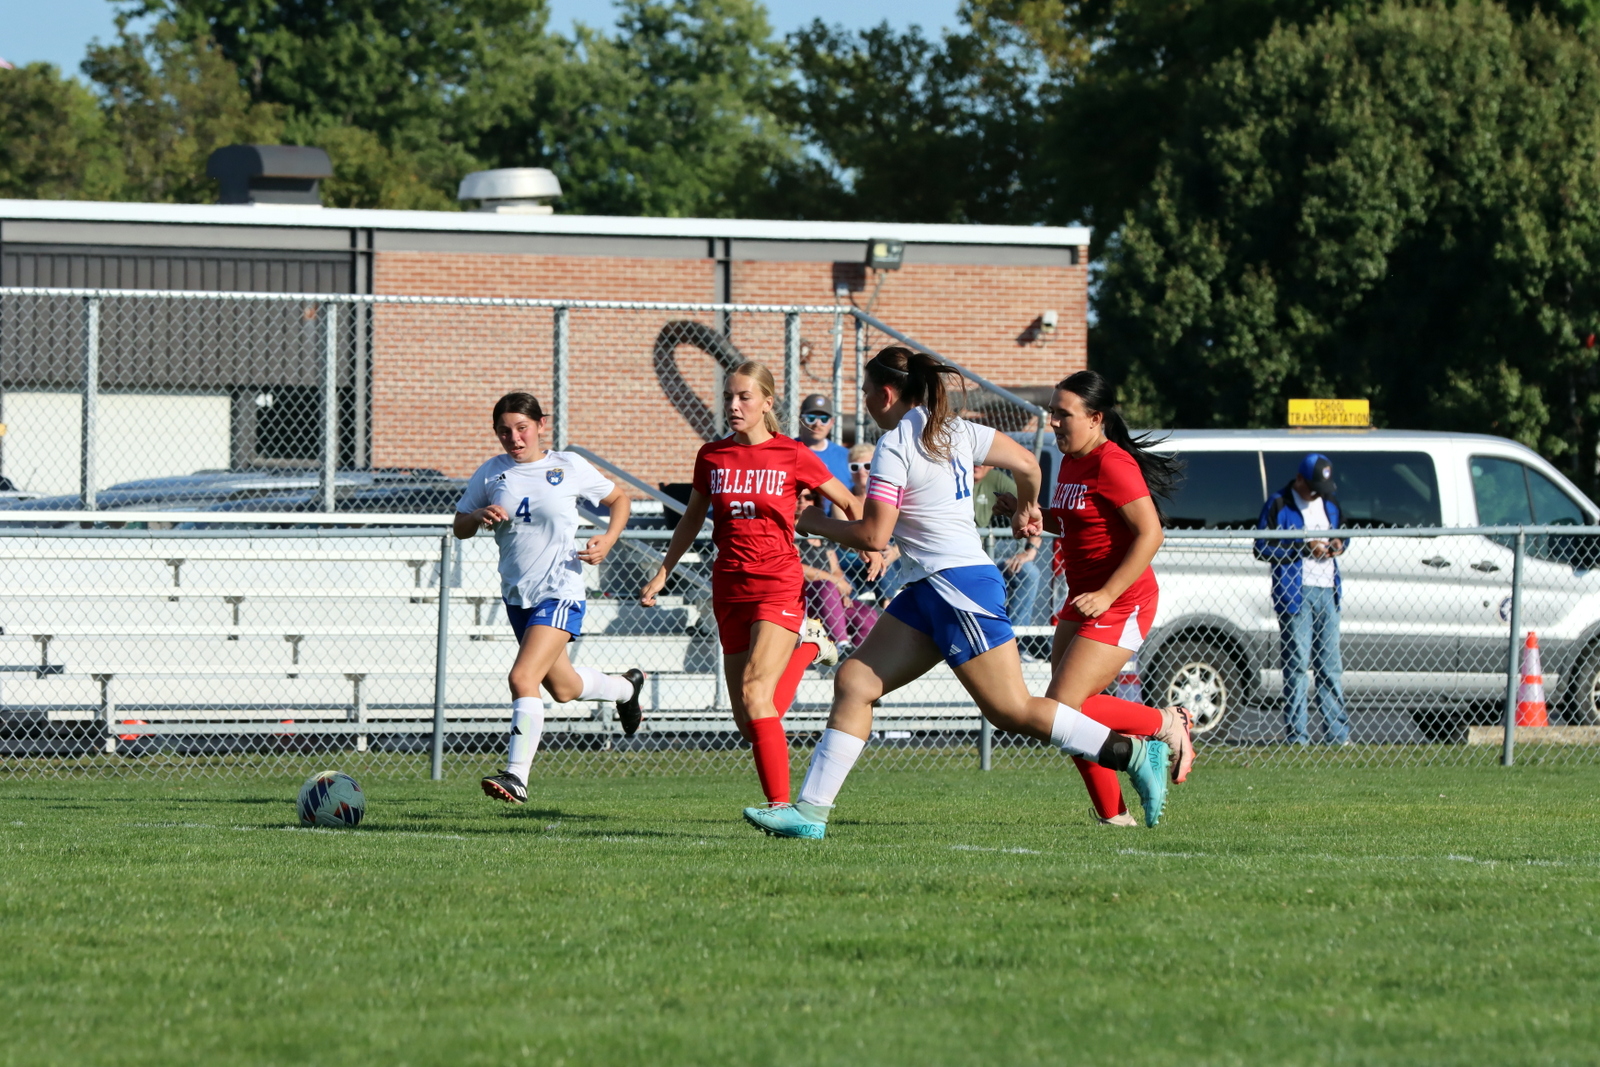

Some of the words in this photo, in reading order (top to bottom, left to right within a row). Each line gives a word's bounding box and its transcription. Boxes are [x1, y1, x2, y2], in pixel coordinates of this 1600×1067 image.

[1314, 400, 1345, 412] SCHOOL
[1290, 412, 1370, 424] TRANSPORTATION
[710, 468, 787, 496] BELLEVUE
[949, 455, 971, 500] 11
[515, 497, 531, 523] 4
[729, 500, 756, 520] 20
